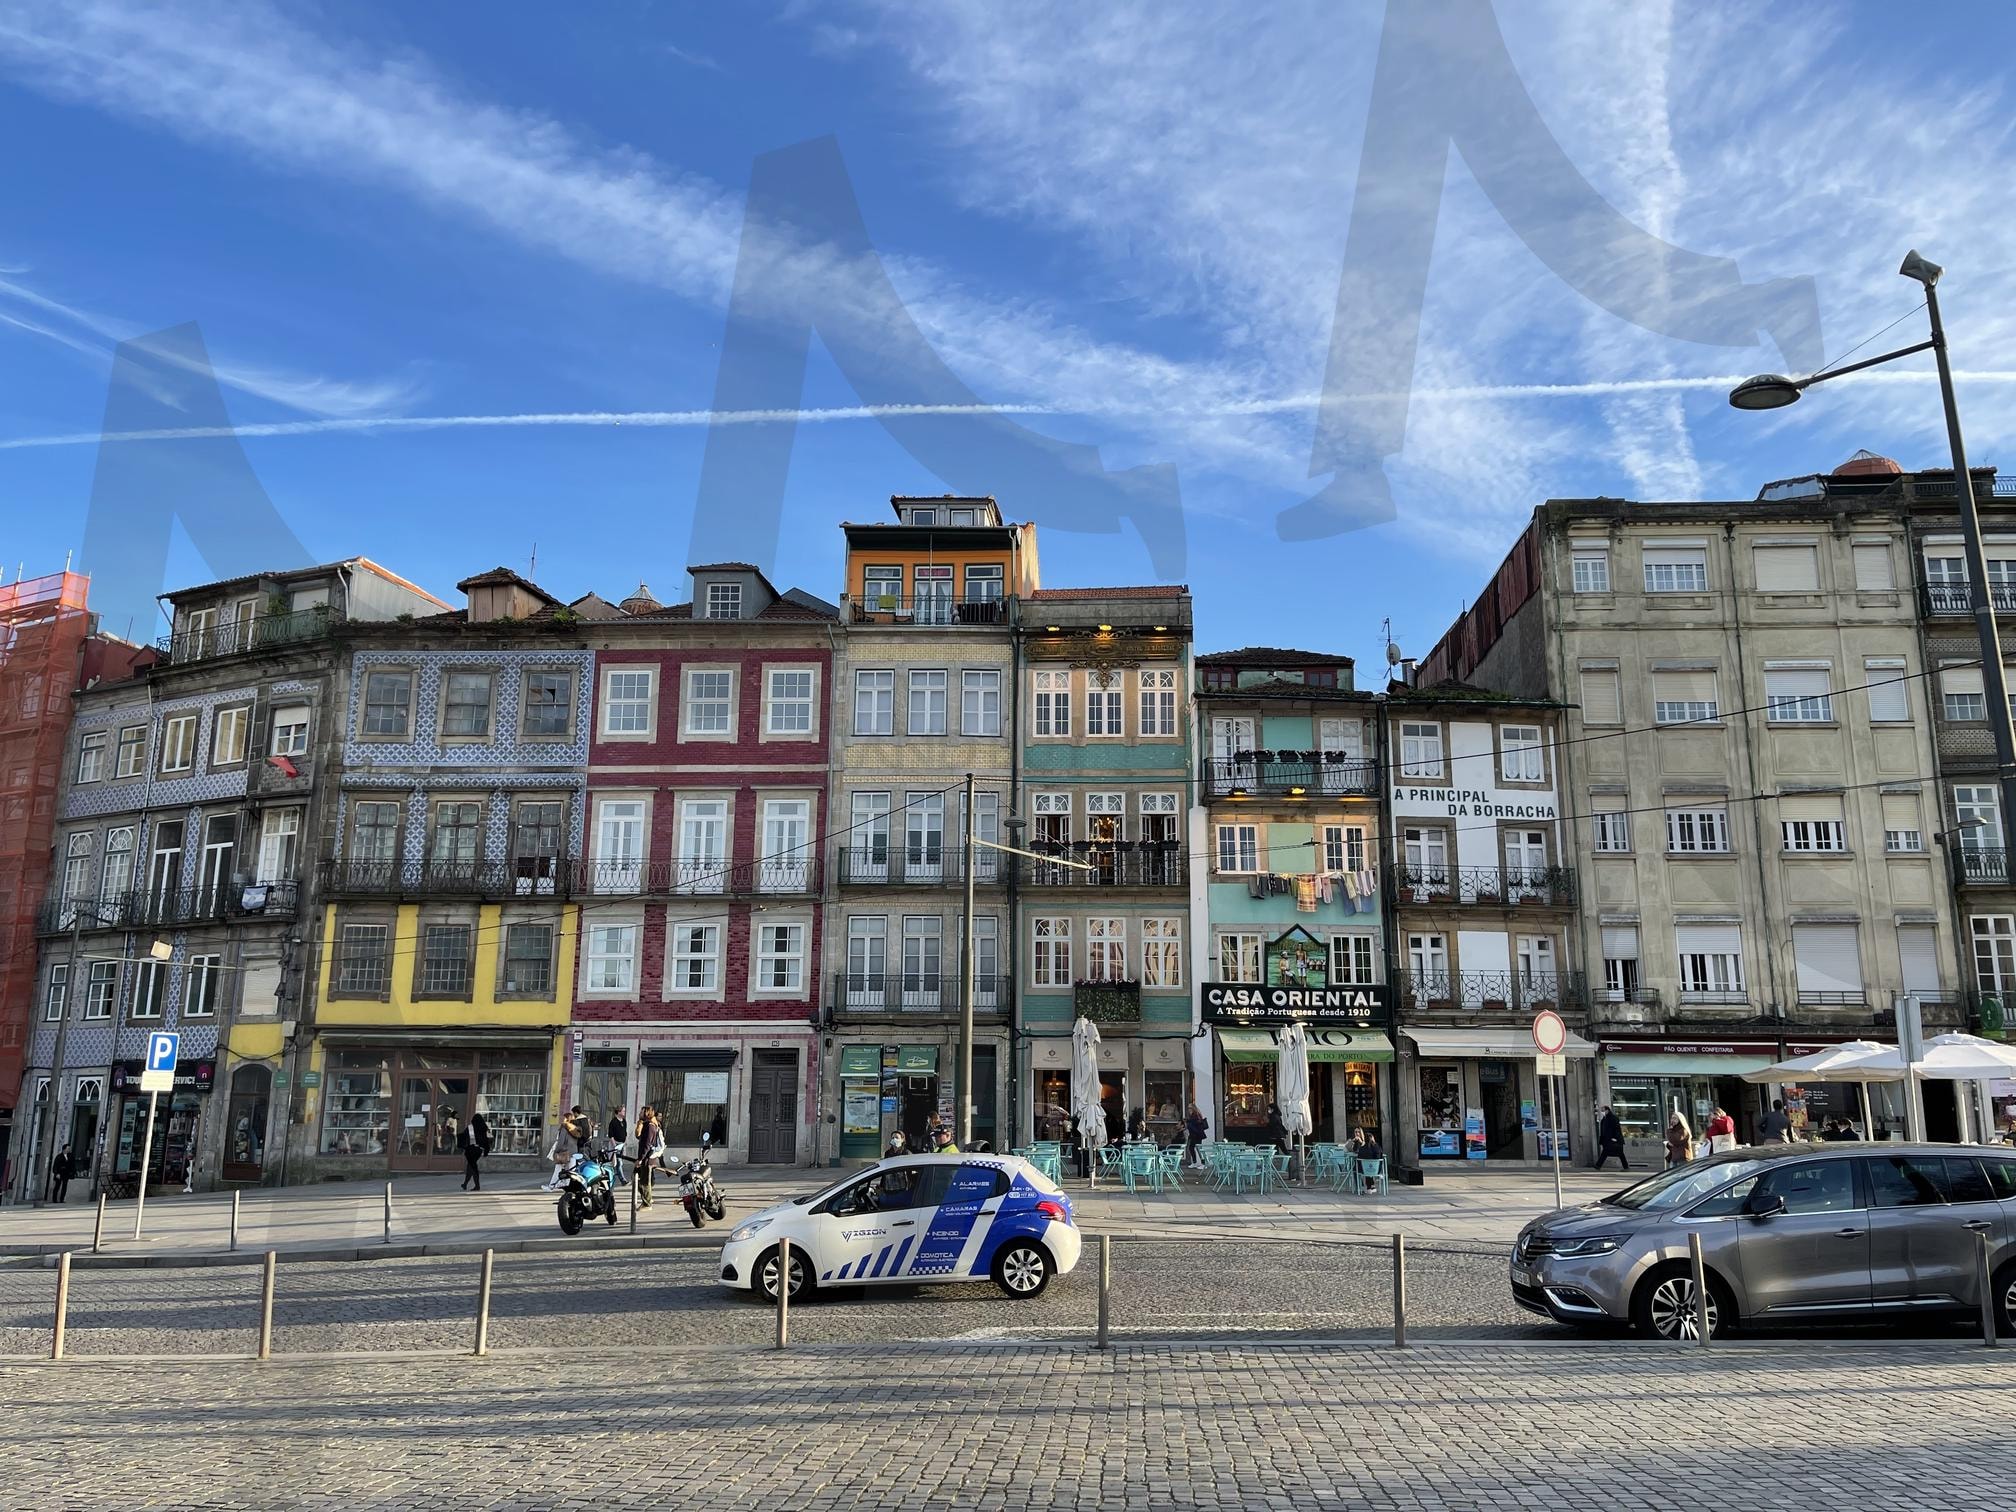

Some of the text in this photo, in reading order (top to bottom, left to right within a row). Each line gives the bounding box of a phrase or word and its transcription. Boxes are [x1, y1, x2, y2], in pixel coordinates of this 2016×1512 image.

[1394, 788, 1490, 803] A PRINCIPAL
[1448, 804, 1556, 818] DA BORRACHA
[1208, 989, 1382, 1007] CASA ORIENTAL
[1216, 1007, 1371, 1018] A Tradição Portuguesa desde 1910
[153, 1037, 172, 1069] P
